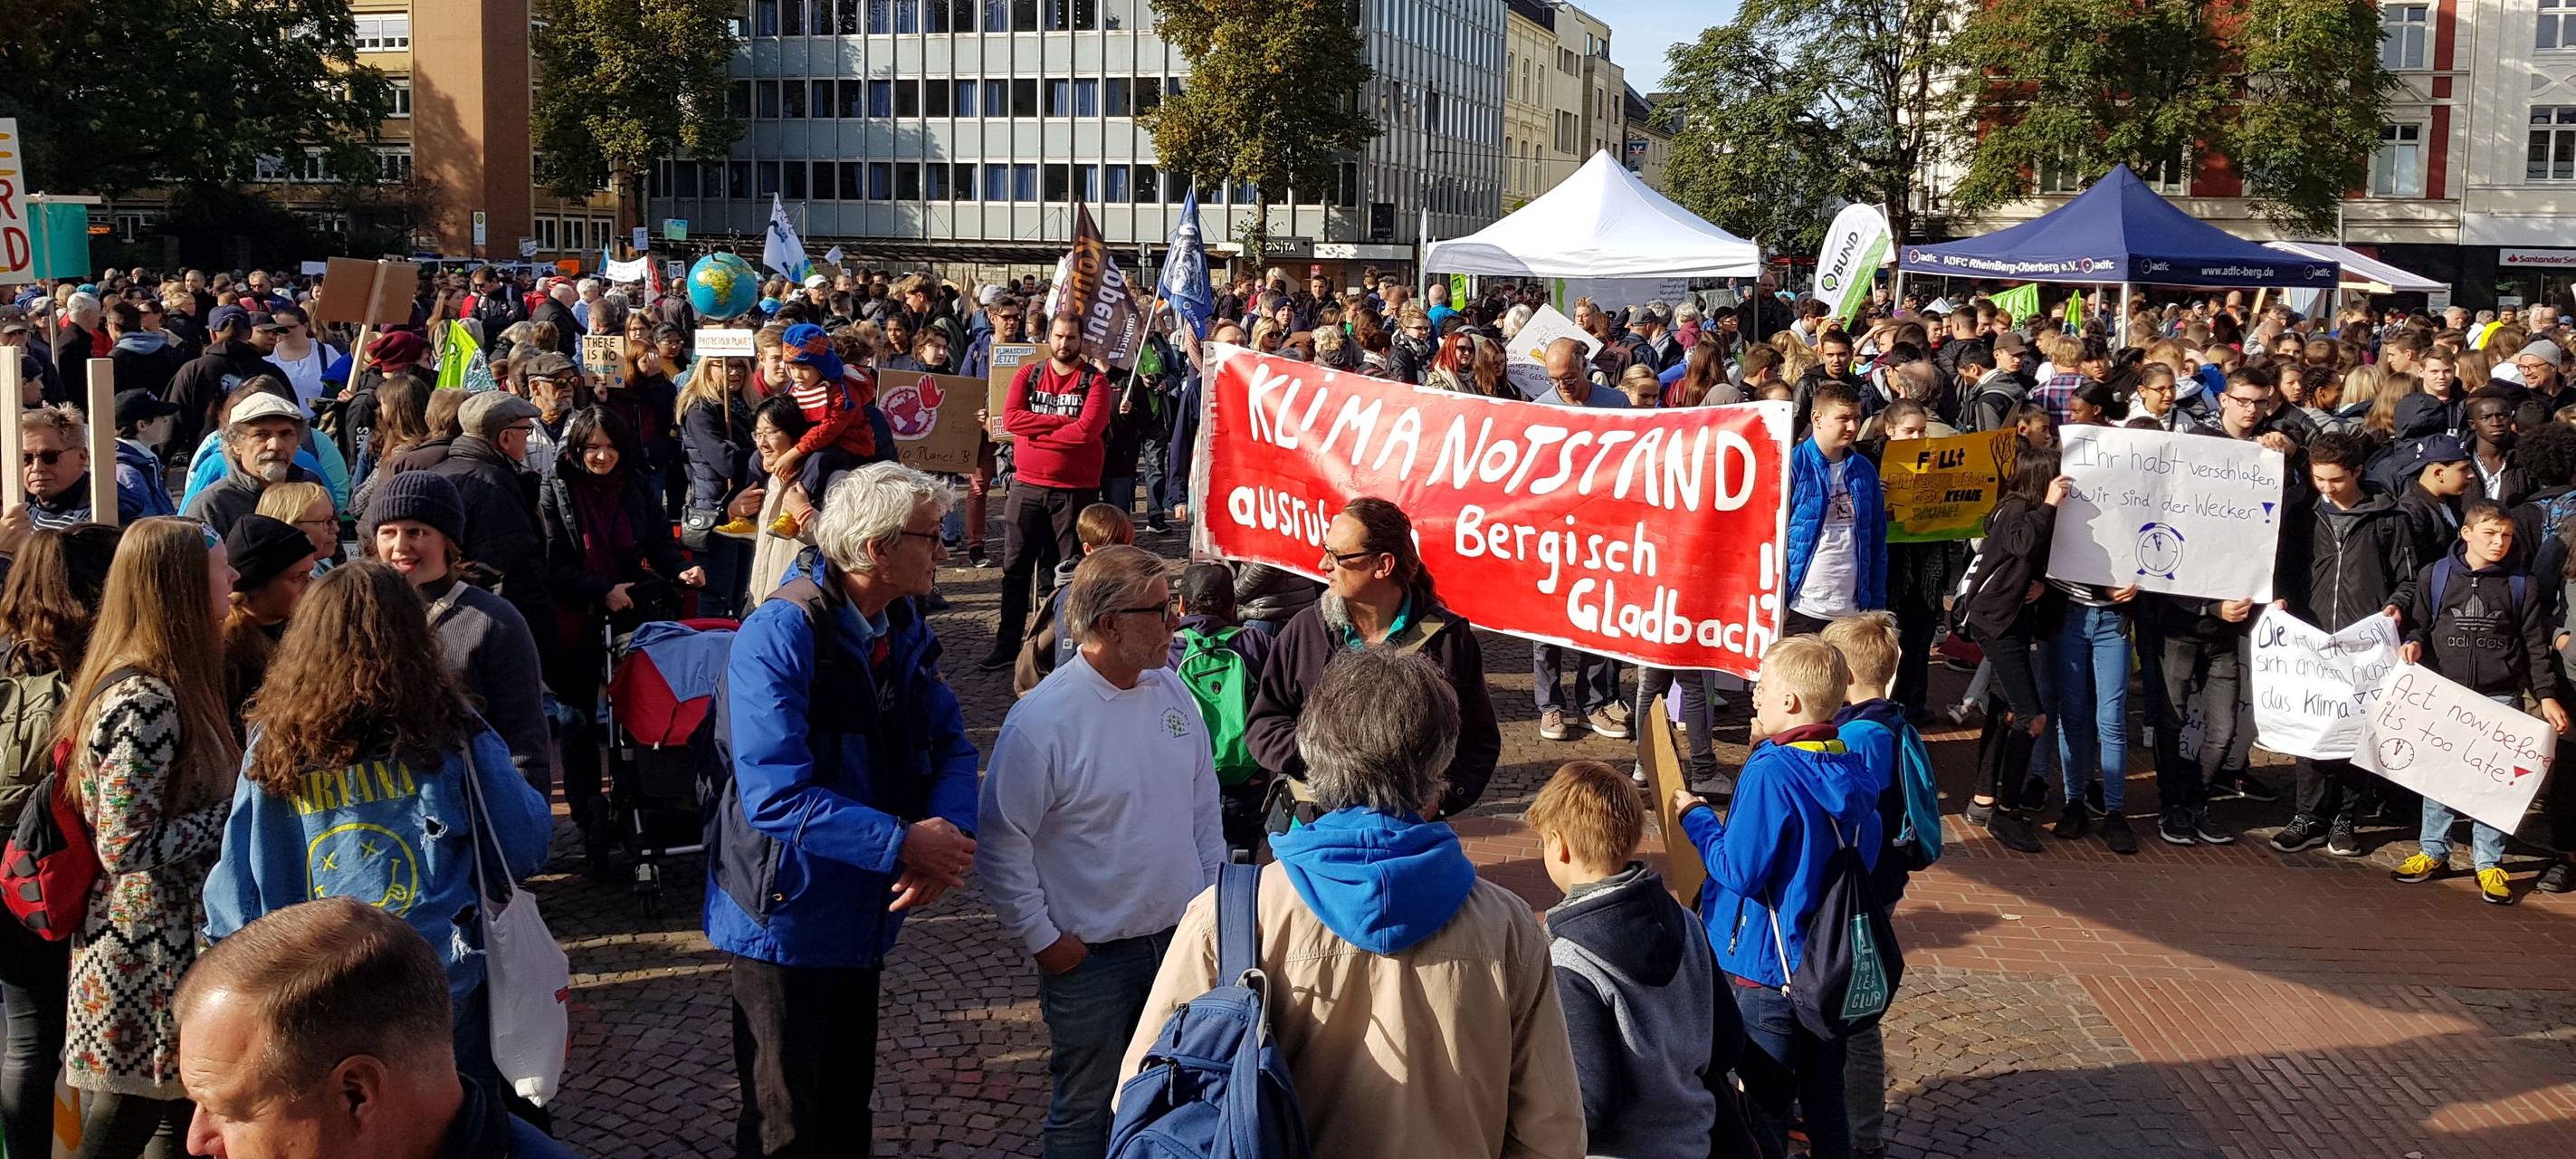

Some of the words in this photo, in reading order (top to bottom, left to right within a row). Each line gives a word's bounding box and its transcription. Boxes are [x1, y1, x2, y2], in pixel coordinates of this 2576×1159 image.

[1265, 240, 1297, 254] ONITA
[1833, 231, 1858, 276] BUND
[1921, 252, 1937, 263] adfc
[1943, 255, 1968, 267] ADFC
[1969, 257, 2059, 274] RheinBerg-Oberberg
[2061, 261, 2078, 272] e.V.
[2094, 260, 2114, 270] adfc
[2519, 254, 2562, 263] Santander
[2152, 261, 2171, 272] adfc
[2201, 266, 2275, 279] www.adfc-berg.de
[2314, 268, 2331, 277] adfc
[585, 337, 616, 348] THERE
[587, 350, 598, 360] IS
[602, 350, 617, 360] NO
[961, 448, 971, 463] B
[2073, 436, 2122, 468] Ihr
[2130, 442, 2185, 474] habt
[1944, 489, 1983, 503] KEINE
[2121, 489, 2151, 508] sind
[2161, 494, 2190, 514] der
[1454, 503, 1656, 594] Bergisch
[2258, 616, 2288, 648] Die
[2447, 634, 2505, 649] adidas
[2256, 654, 2288, 674] sich
[2261, 685, 2291, 713] das
[2391, 673, 2438, 711] Act
[2377, 701, 2407, 731] it's
[2418, 722, 2454, 752] too
[285, 760, 416, 818] NIRVANA
